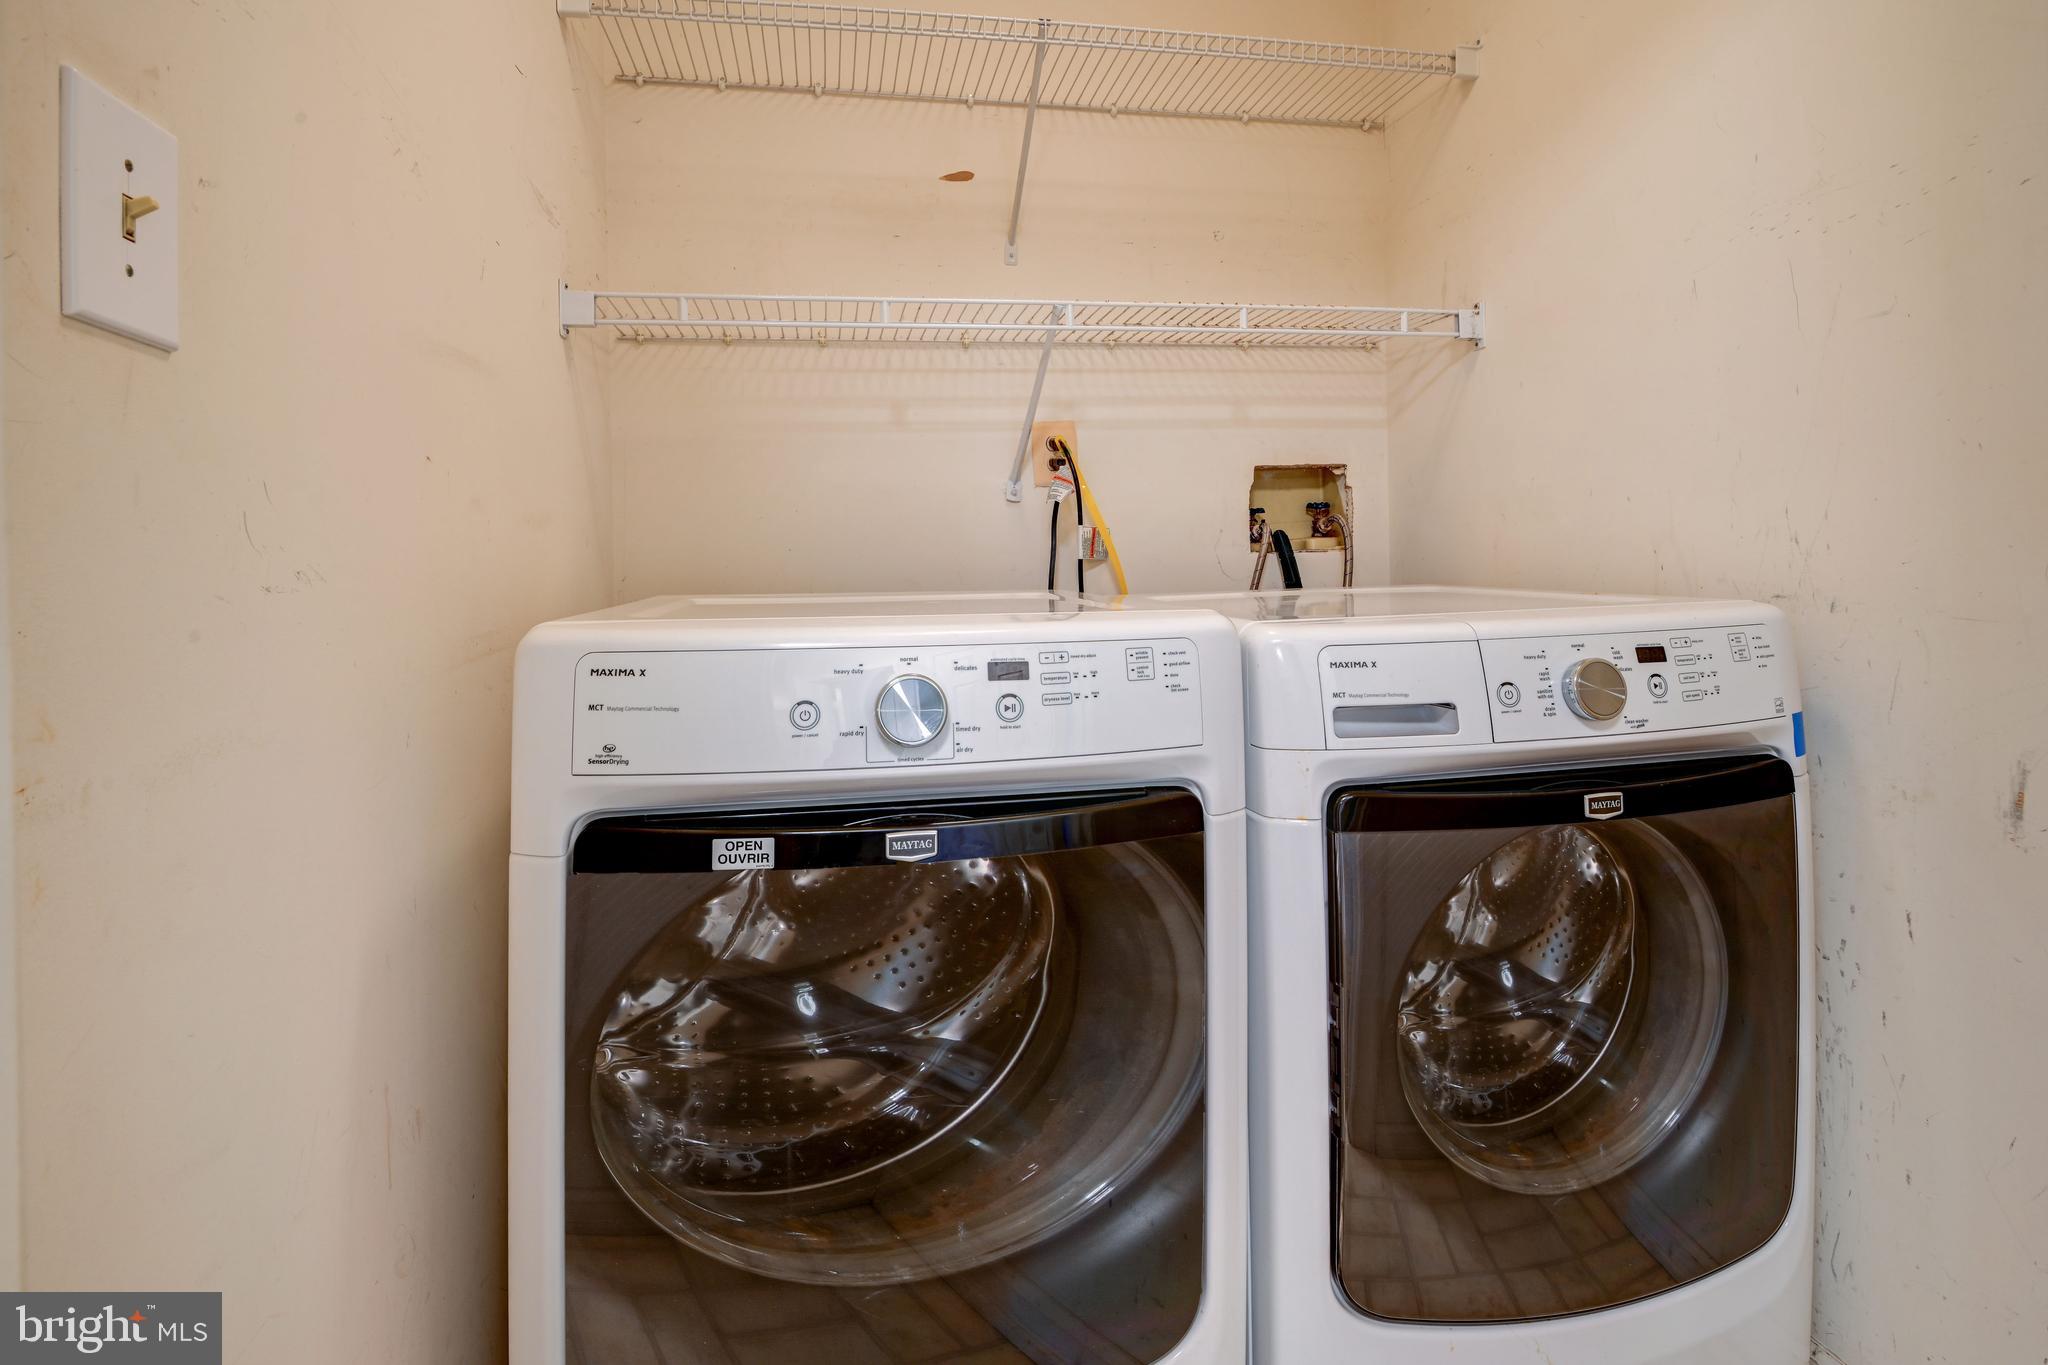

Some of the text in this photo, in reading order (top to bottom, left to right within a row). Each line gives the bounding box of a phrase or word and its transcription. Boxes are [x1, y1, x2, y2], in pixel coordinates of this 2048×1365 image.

[1329, 661, 1368, 669] MAXIMA
[590, 668, 647, 677] MAXIMA X
[587, 758, 630, 766] SensorDrying
[1591, 800, 1621, 809] MAYTAG
[724, 840, 763, 852] OPEN
[892, 839, 933, 850] MAYTAG
[718, 853, 769, 865] OUVRIR
